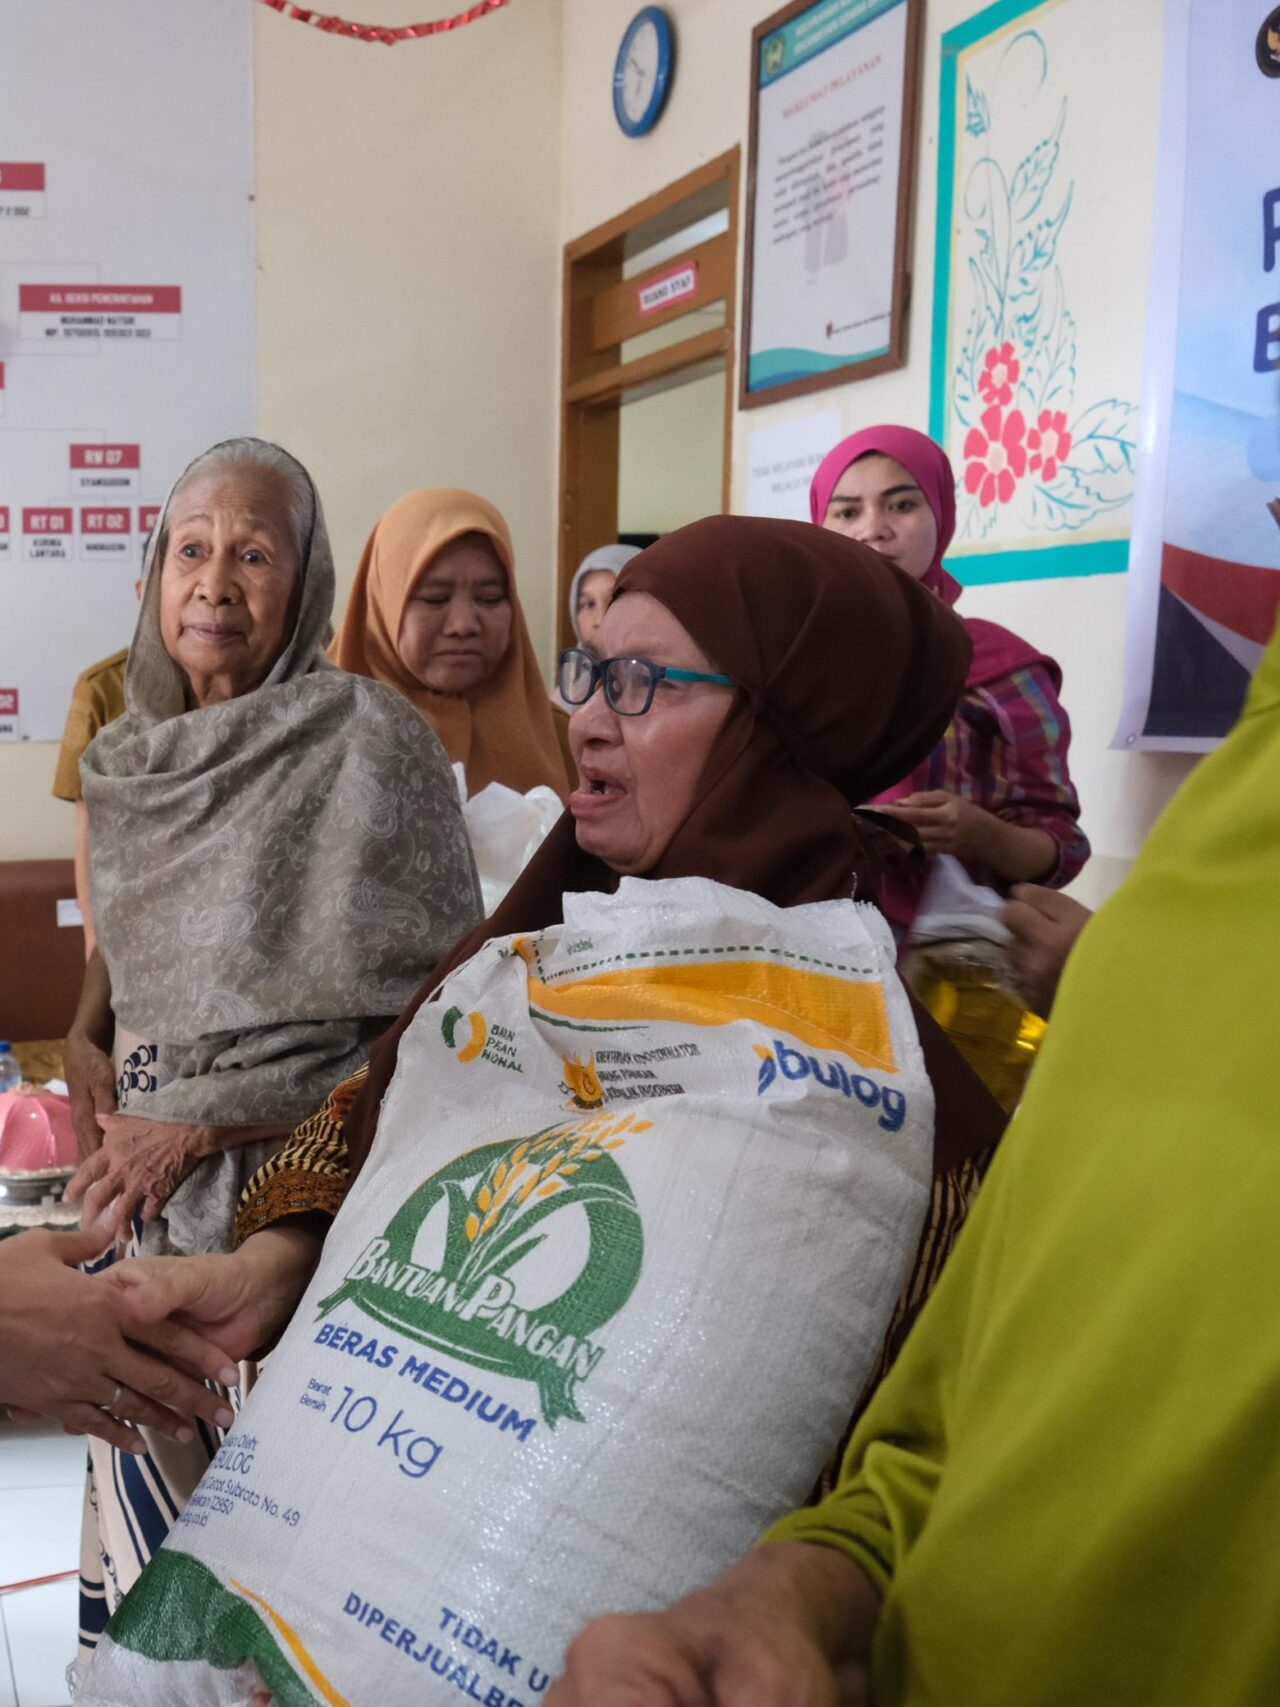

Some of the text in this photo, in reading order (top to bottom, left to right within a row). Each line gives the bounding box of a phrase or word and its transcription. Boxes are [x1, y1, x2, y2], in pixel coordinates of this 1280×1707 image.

[84, 449, 123, 465] RW 07
[30, 514, 64, 530] RT 01
[86, 513, 124, 529] RT 02
[773, 1040, 906, 1132] bulog
[346, 1236, 606, 1384] BANTUAN PANGAN
[314, 1322, 538, 1442] BERAS MEDIUM
[330, 1386, 444, 1479] 10 kg
[261, 1496, 279, 1519] No.
[282, 1508, 301, 1527] 49
[438, 1607, 522, 1677] TIDAK
